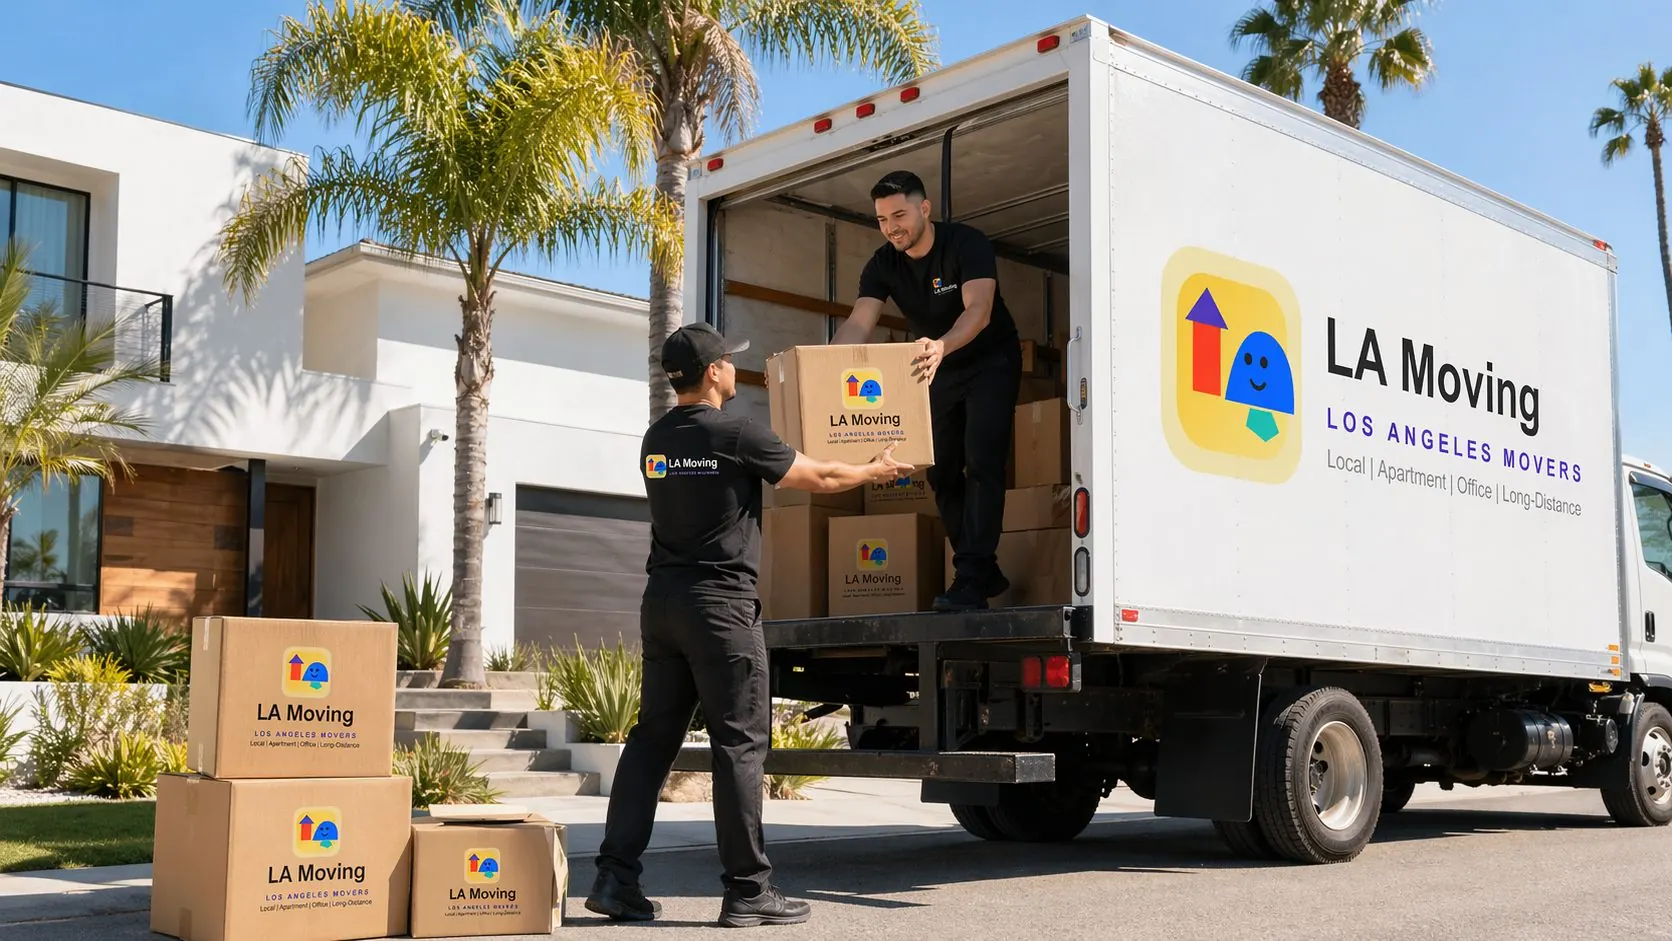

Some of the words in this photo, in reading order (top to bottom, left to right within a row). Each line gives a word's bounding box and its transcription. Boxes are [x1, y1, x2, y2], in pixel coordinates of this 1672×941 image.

[1327, 316, 1388, 387] LA
[1402, 337, 1539, 437] Moving
[830, 414, 848, 426] LA
[851, 412, 901, 427] Moving
[1327, 407, 1373, 437] LOS
[1387, 422, 1491, 463] ANGELES
[1503, 448, 1581, 482] MOVERS
[668, 458, 682, 468] LA
[682, 457, 718, 470] Moving
[1327, 449, 1366, 475] Local
[1377, 459, 1447, 490] Apartment
[1457, 476, 1493, 499] Office
[1502, 484, 1582, 516] Long-Distance
[845, 574, 860, 584] LA
[862, 574, 902, 586] Moving
[257, 703, 282, 720] LA
[286, 704, 354, 728] Moving
[268, 866, 292, 884] LA
[298, 862, 366, 884] Moving
[449, 888, 466, 900] LA
[469, 888, 516, 902] Moving
